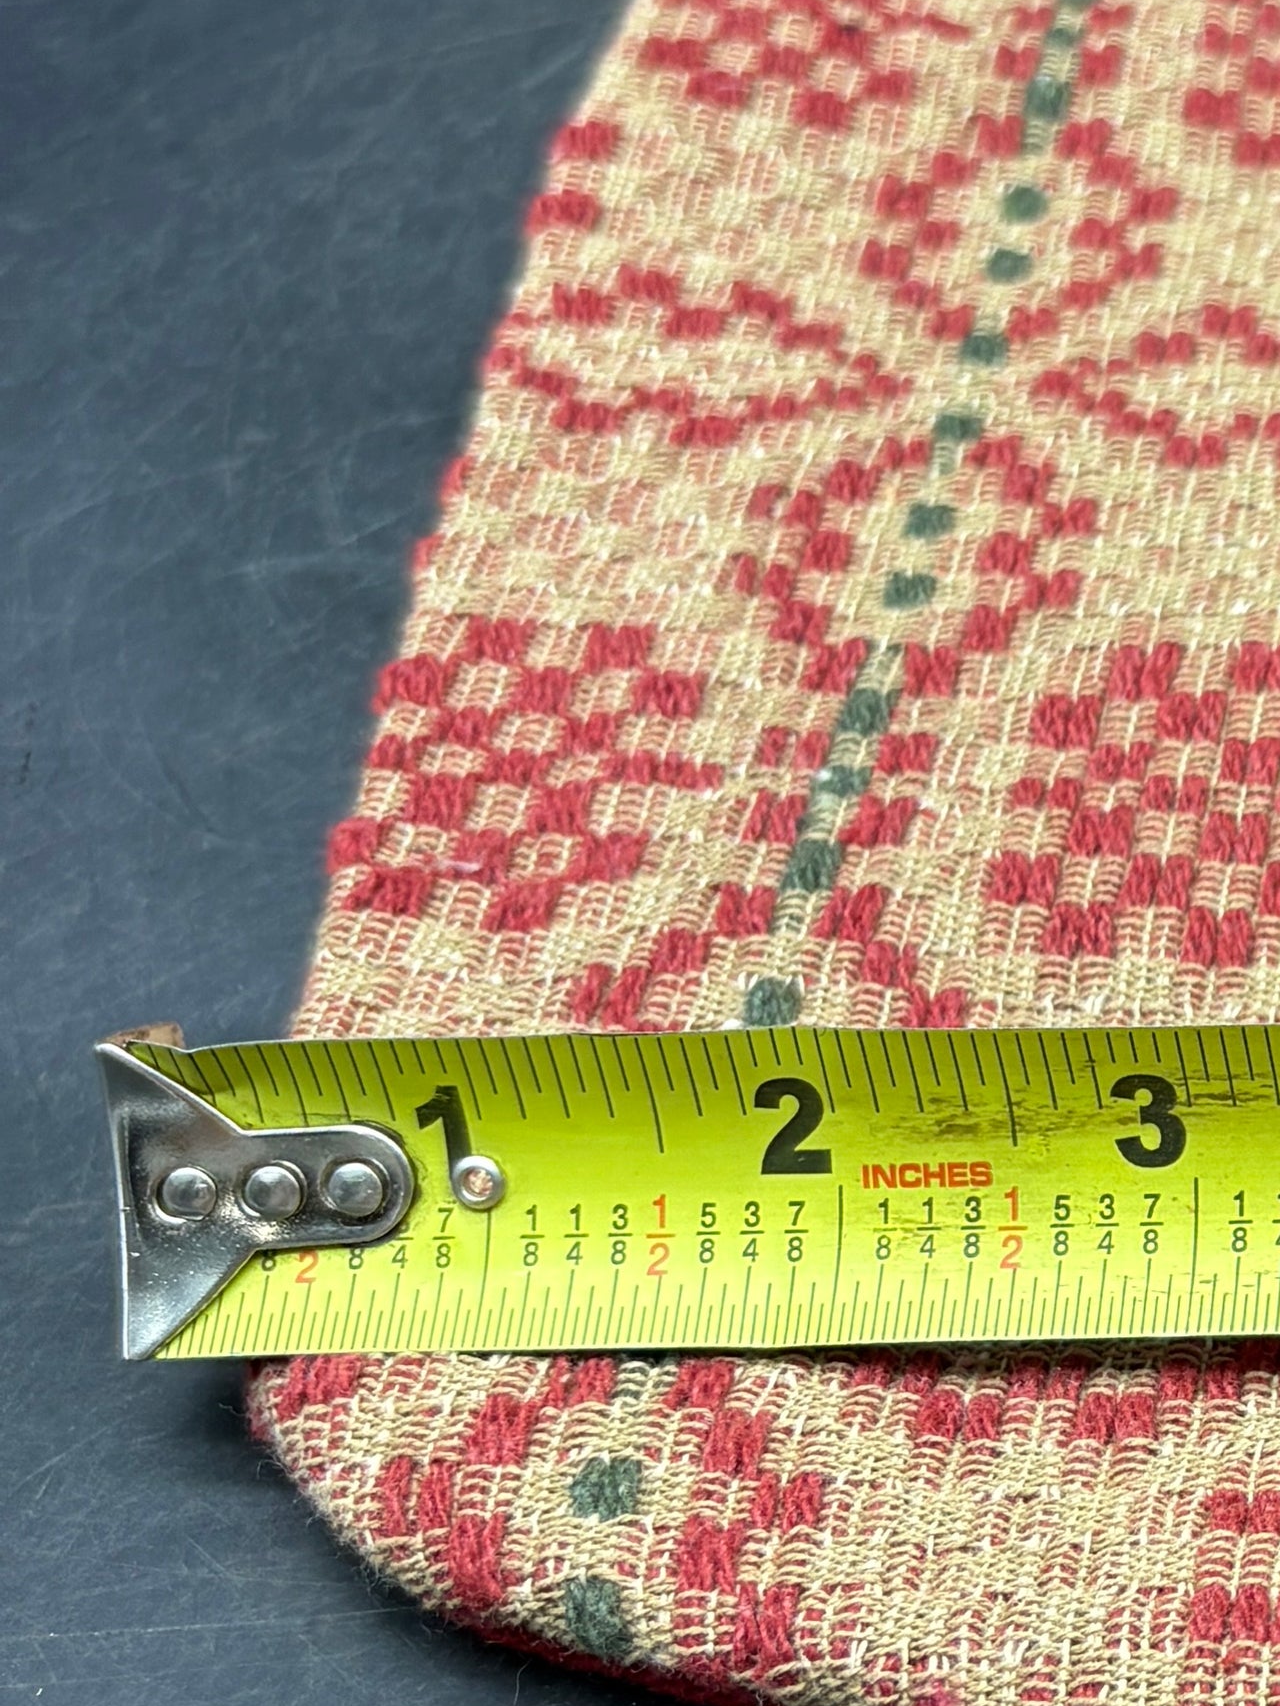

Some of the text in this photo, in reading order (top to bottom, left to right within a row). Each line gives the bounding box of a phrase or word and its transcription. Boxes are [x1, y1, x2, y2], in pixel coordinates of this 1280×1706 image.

[415, 1084, 473, 1179] 1
[754, 1077, 831, 1175] 2
[1110, 1073, 1186, 1168] 3
[862, 1161, 994, 1189] INCHES
